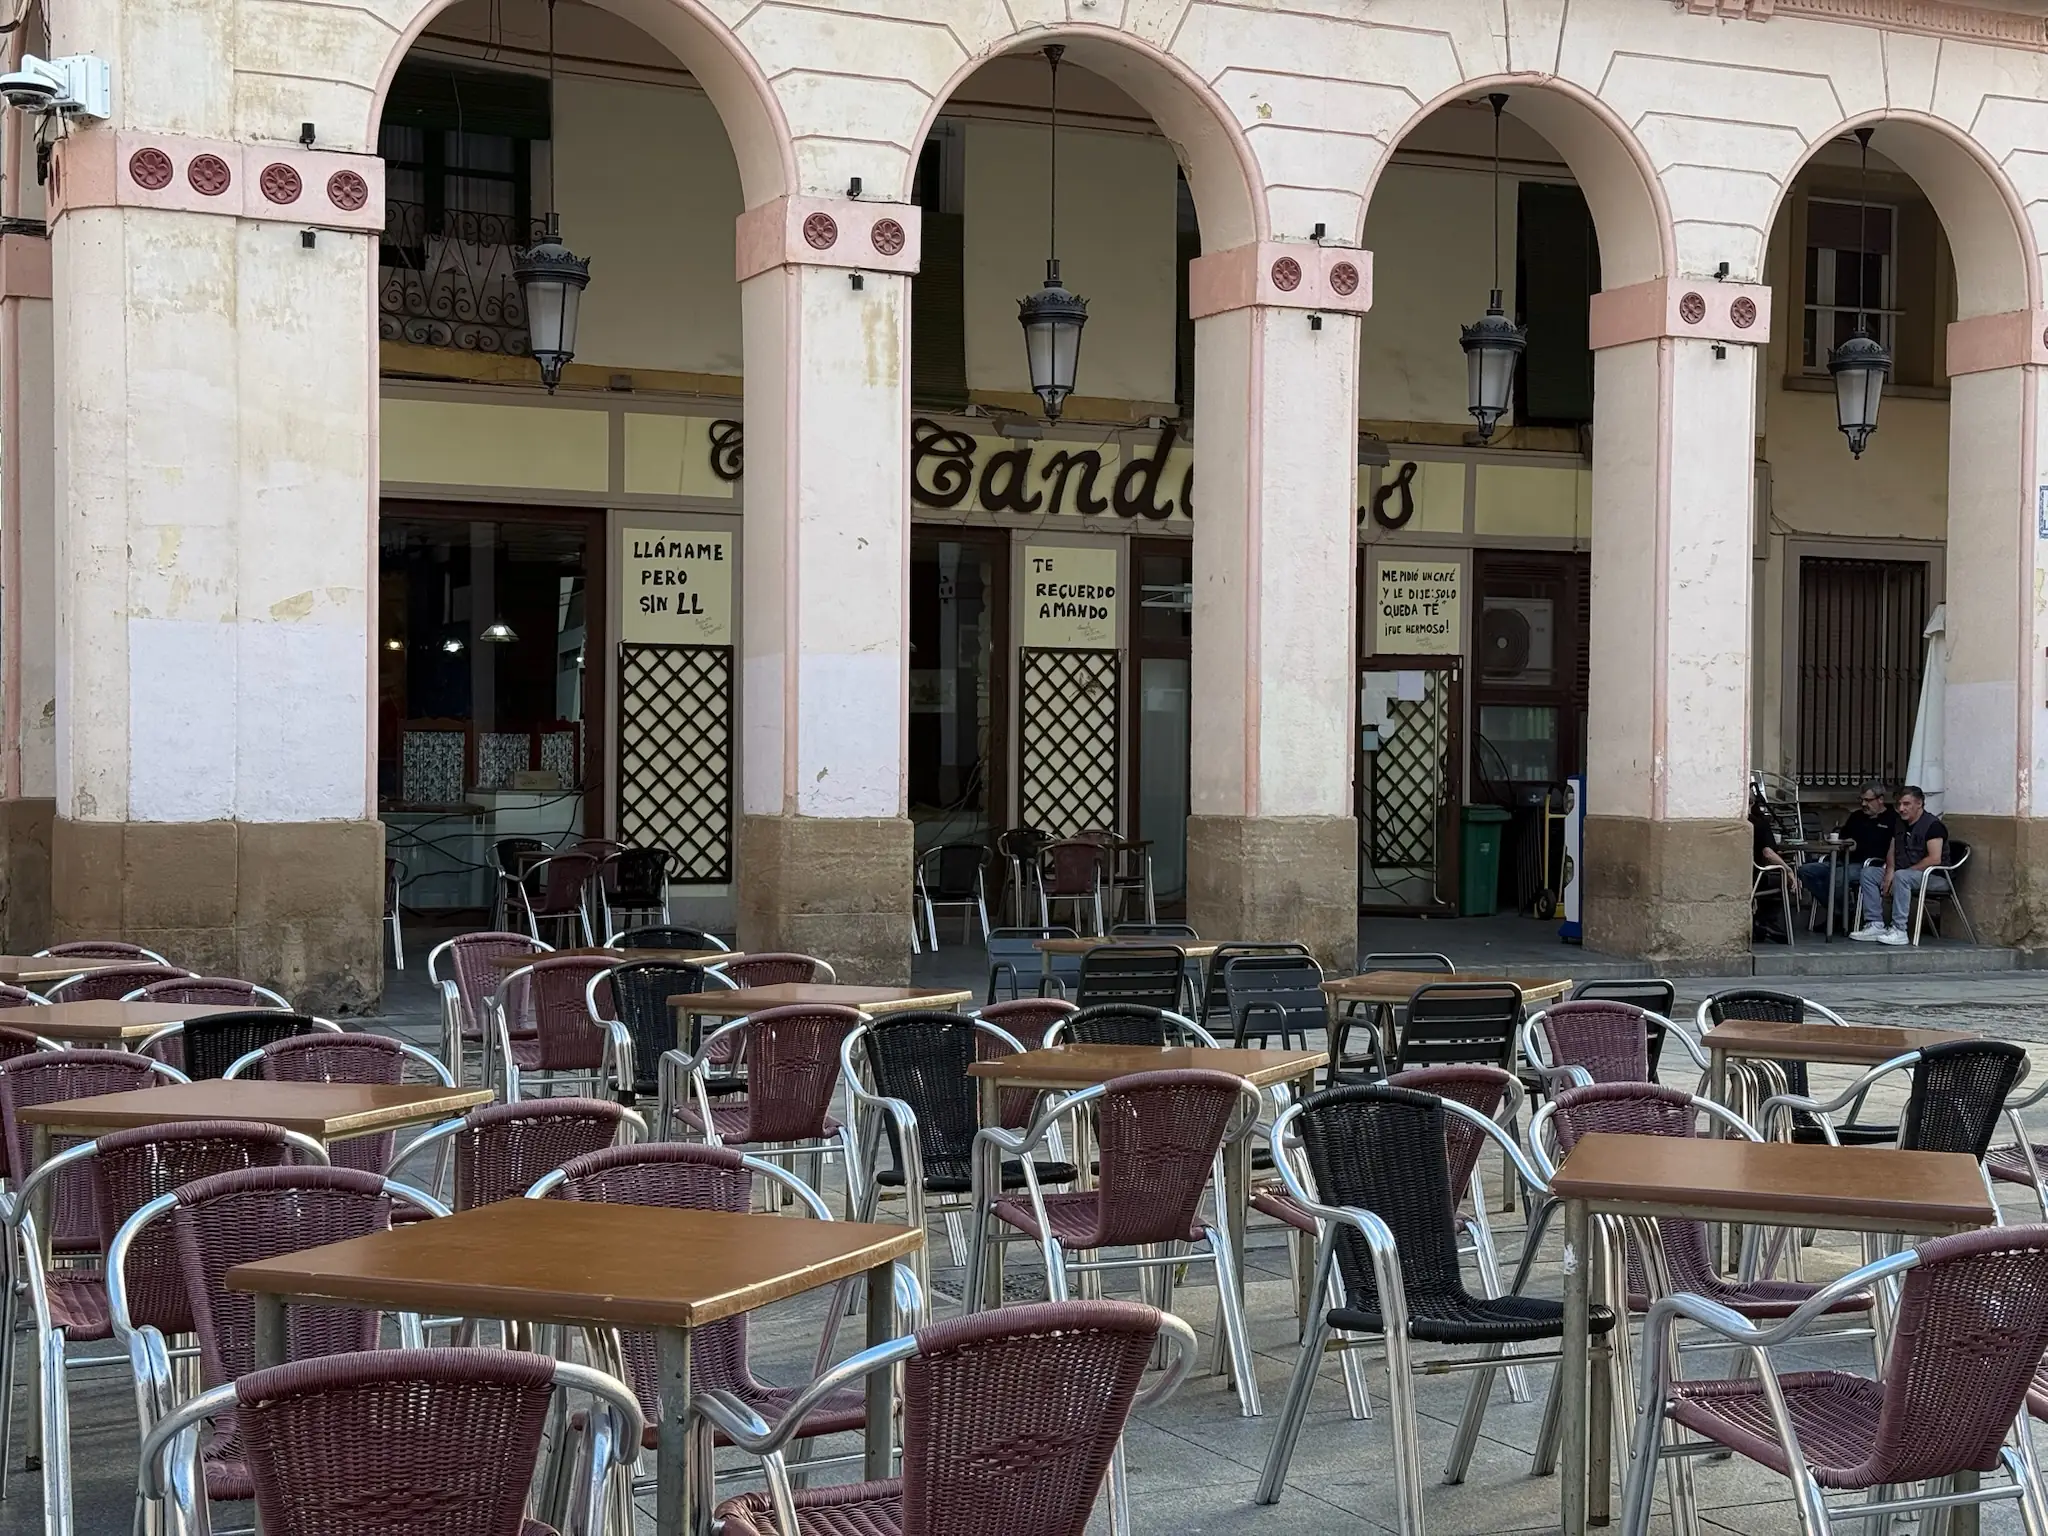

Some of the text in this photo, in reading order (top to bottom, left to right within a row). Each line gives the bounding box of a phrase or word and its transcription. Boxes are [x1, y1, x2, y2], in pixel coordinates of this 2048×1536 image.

[633, 535, 724, 561] LLÁMAME
[1032, 558, 1054, 574] TE
[641, 569, 688, 586] PERO
[1382, 568, 1456, 582] ME PIDIÓ UN CAFÉ
[1036, 583, 1116, 600] RECUERDO
[1383, 587, 1389, 599] Y
[1394, 588, 1403, 599] LE
[1435, 588, 1457, 600] SOLO
[639, 592, 704, 615] SIN LL
[1039, 602, 1108, 620] AMANDO
[1384, 619, 1450, 637] ¡FUE HERMOSO!
